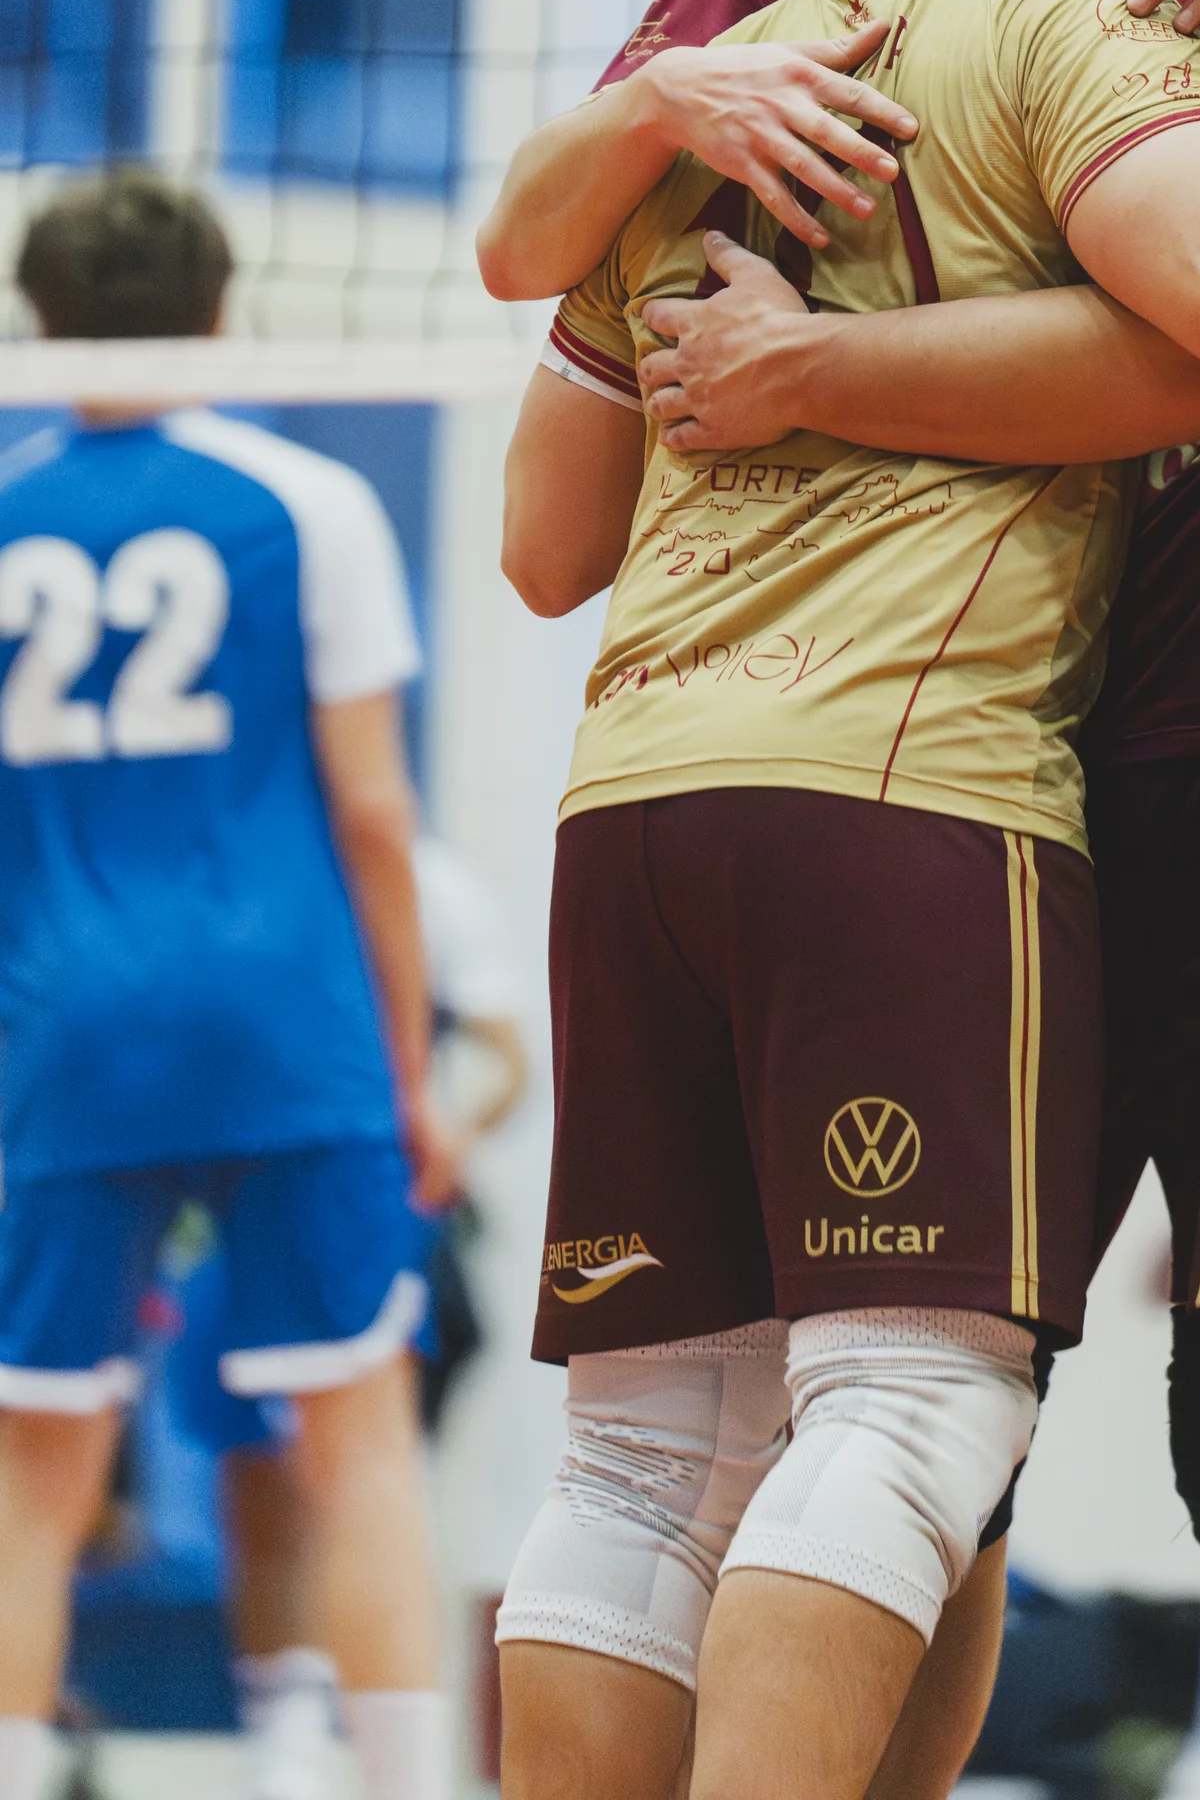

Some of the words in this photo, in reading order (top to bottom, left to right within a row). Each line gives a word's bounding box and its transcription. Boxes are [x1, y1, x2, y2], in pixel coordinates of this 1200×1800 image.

[660, 473, 680, 500] IL
[667, 547, 732, 577] 2.0
[0, 525, 234, 768] 22
[804, 1214, 945, 1258] Unicar
